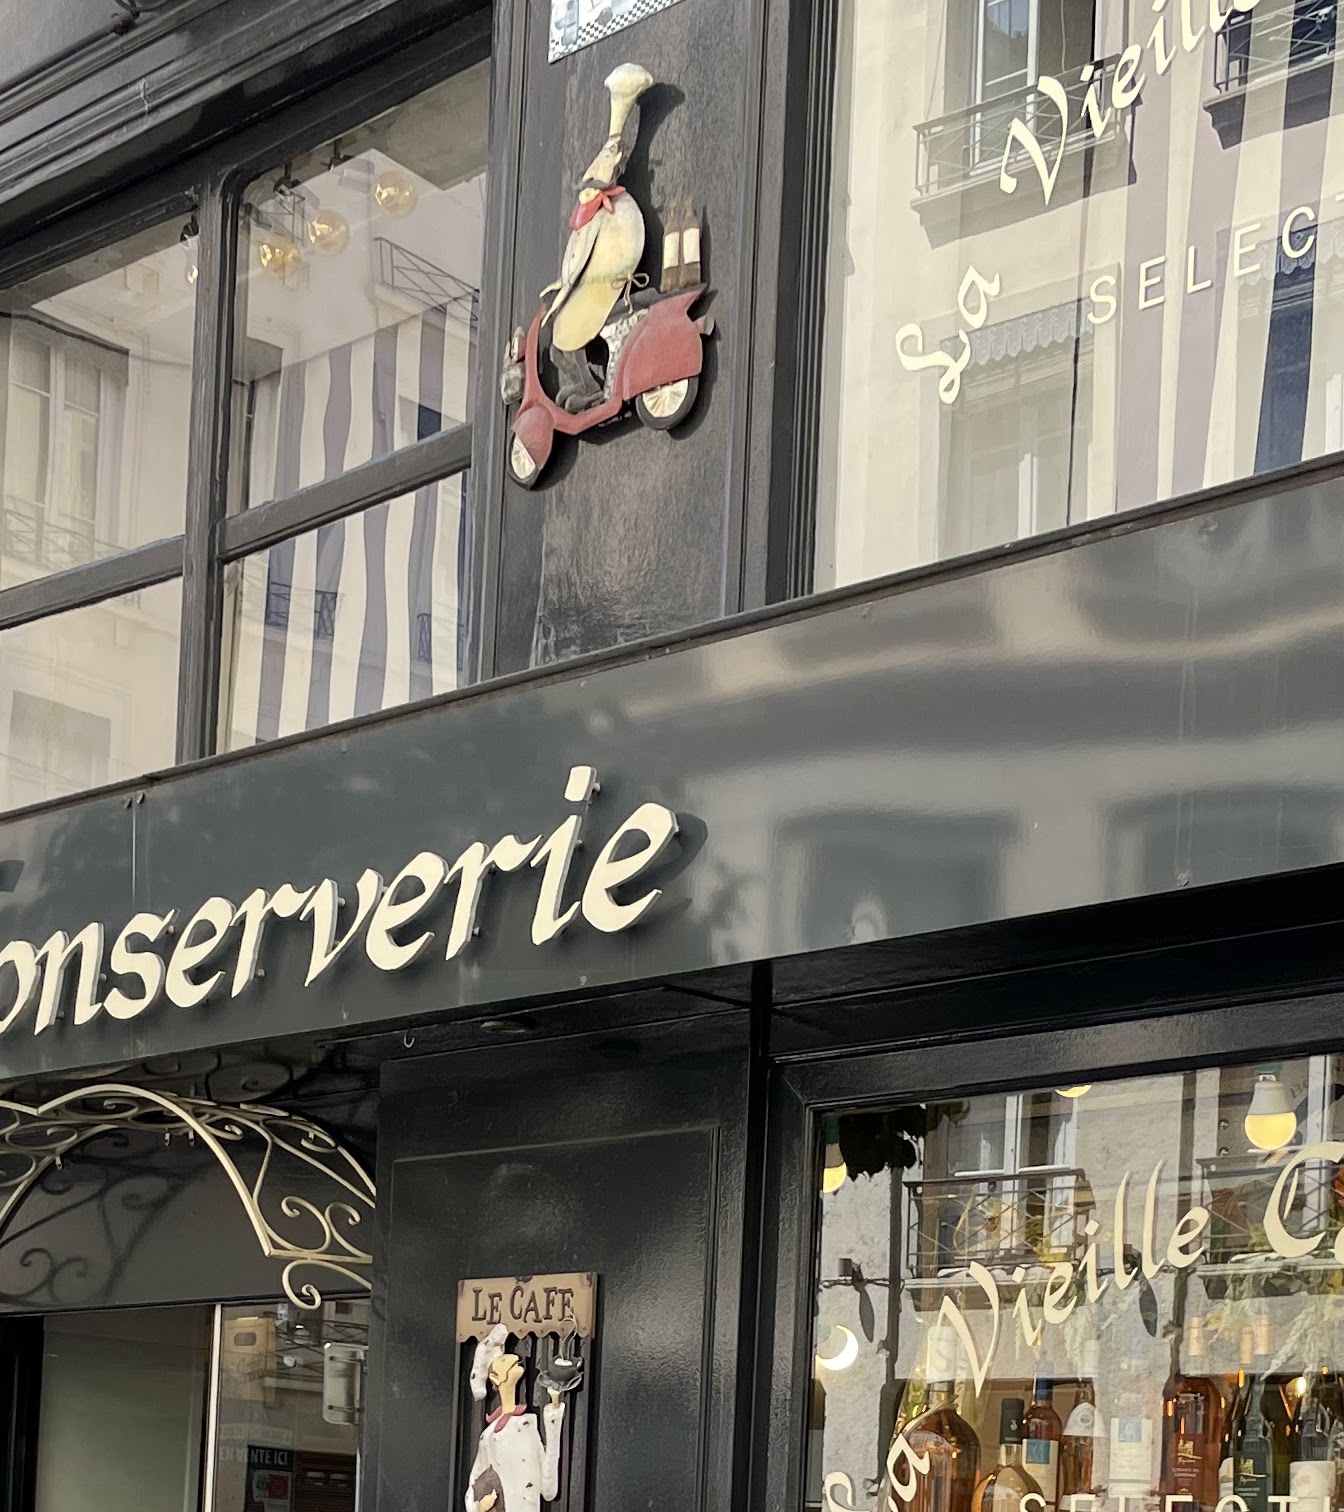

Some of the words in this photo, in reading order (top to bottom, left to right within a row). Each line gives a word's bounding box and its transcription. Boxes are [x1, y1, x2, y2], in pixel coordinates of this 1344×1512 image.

[896, 266, 1002, 404] La
[471, 1286, 503, 1325] LE
[935, 1158, 1212, 1398] Vieille
